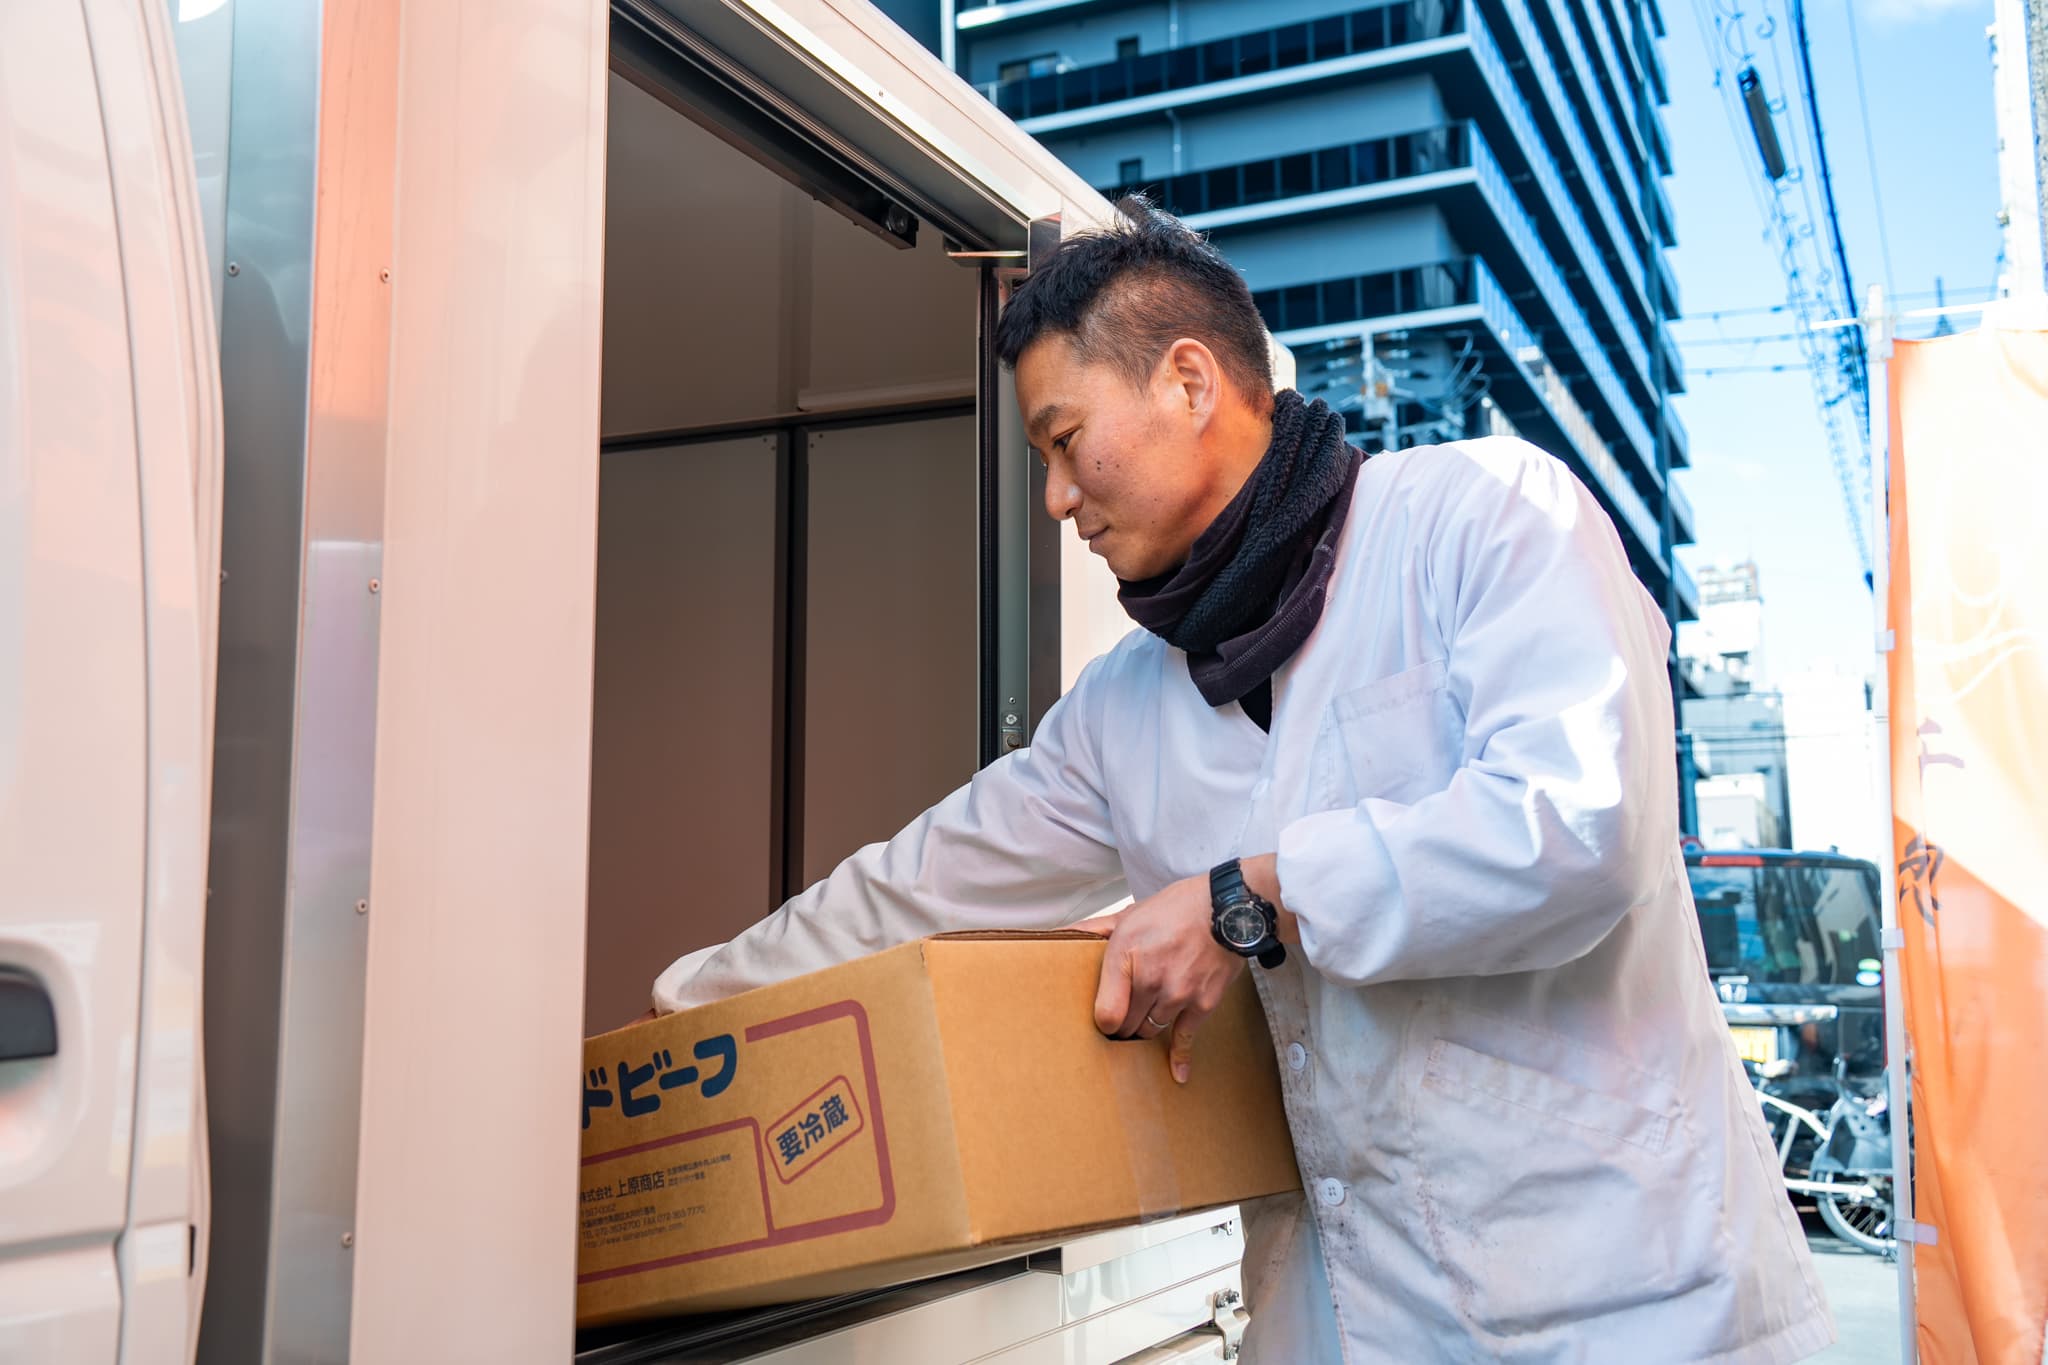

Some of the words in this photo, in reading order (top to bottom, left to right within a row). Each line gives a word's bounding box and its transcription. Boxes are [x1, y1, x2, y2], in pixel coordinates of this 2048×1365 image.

[776, 1094, 849, 1166] 要冷蔵
[616, 1170, 665, 1198] 上原商店
